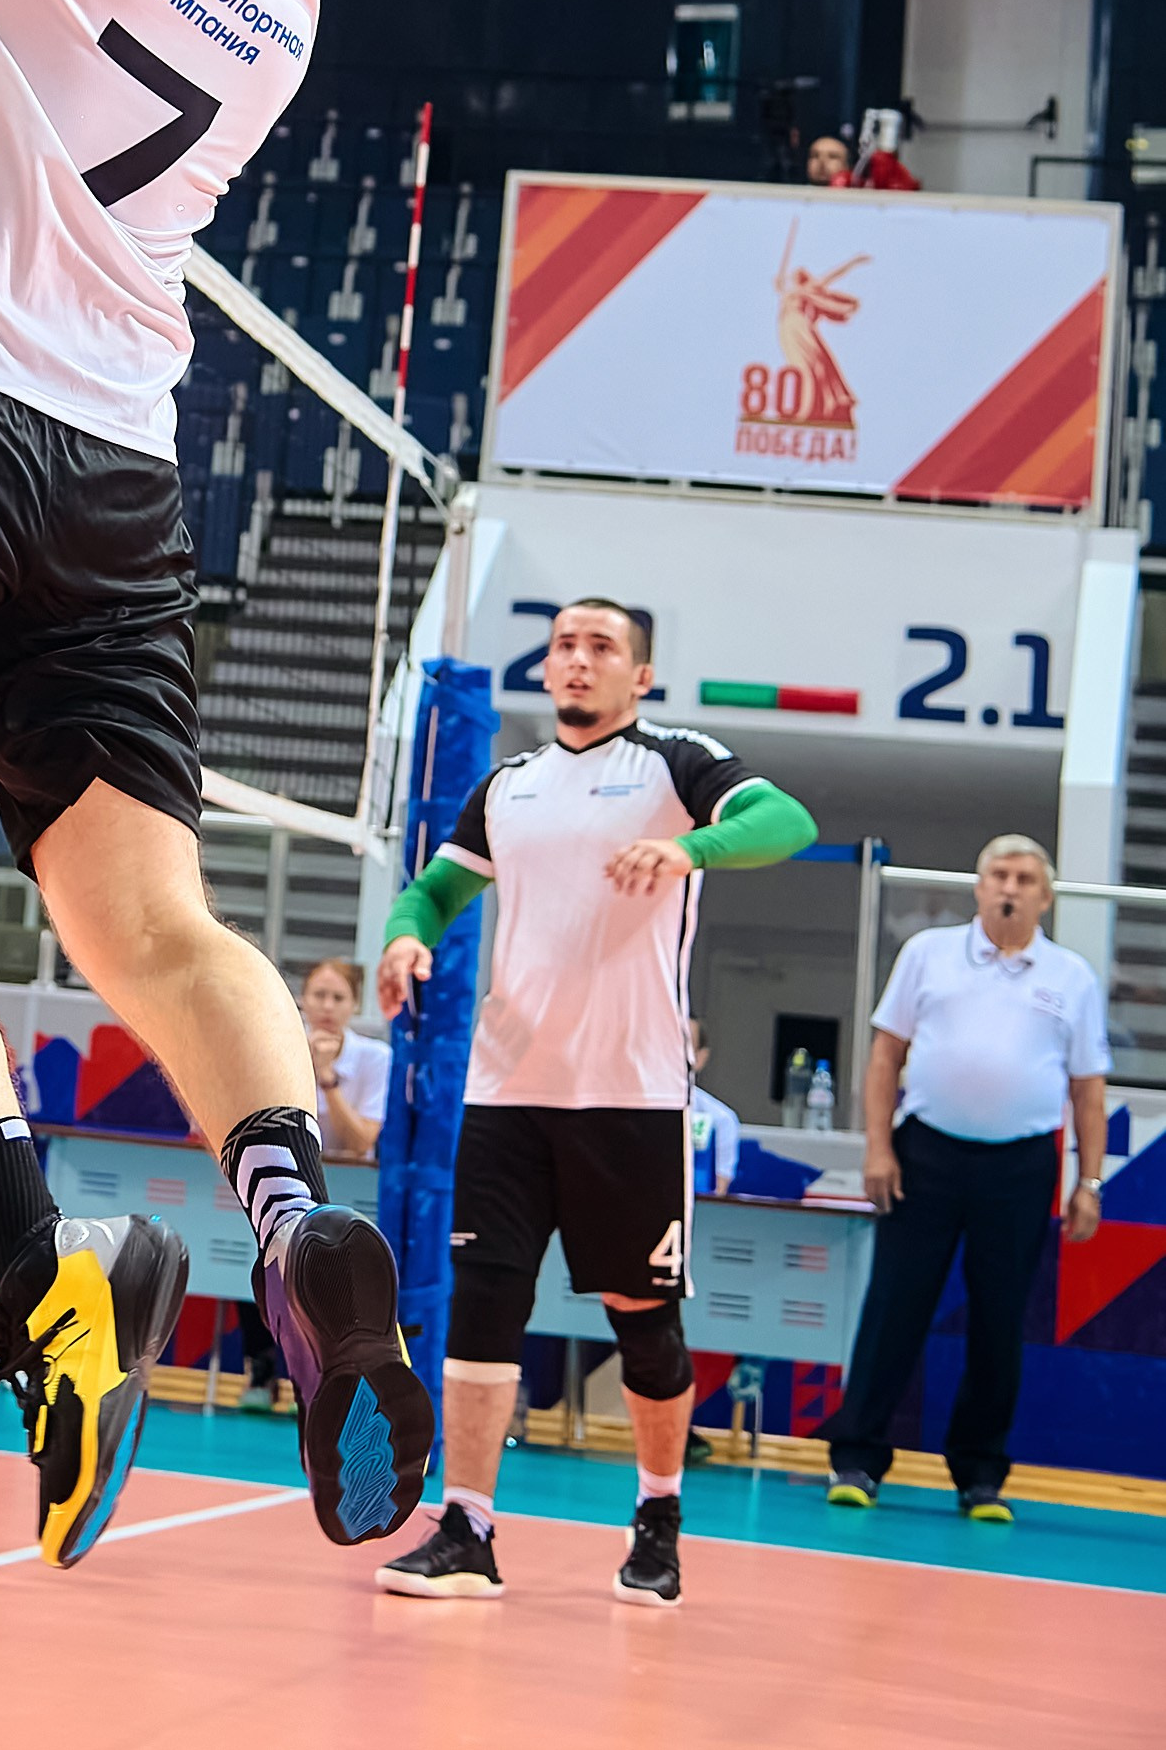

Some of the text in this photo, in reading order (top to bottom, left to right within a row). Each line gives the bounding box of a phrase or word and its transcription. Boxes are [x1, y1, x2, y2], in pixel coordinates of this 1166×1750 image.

[81, 18, 222, 207] 7
[741, 362, 803, 419] 80
[735, 425, 857, 462] ПОБЕДА!
[899, 627, 1065, 729] 2.1
[648, 1219, 683, 1277] 4
